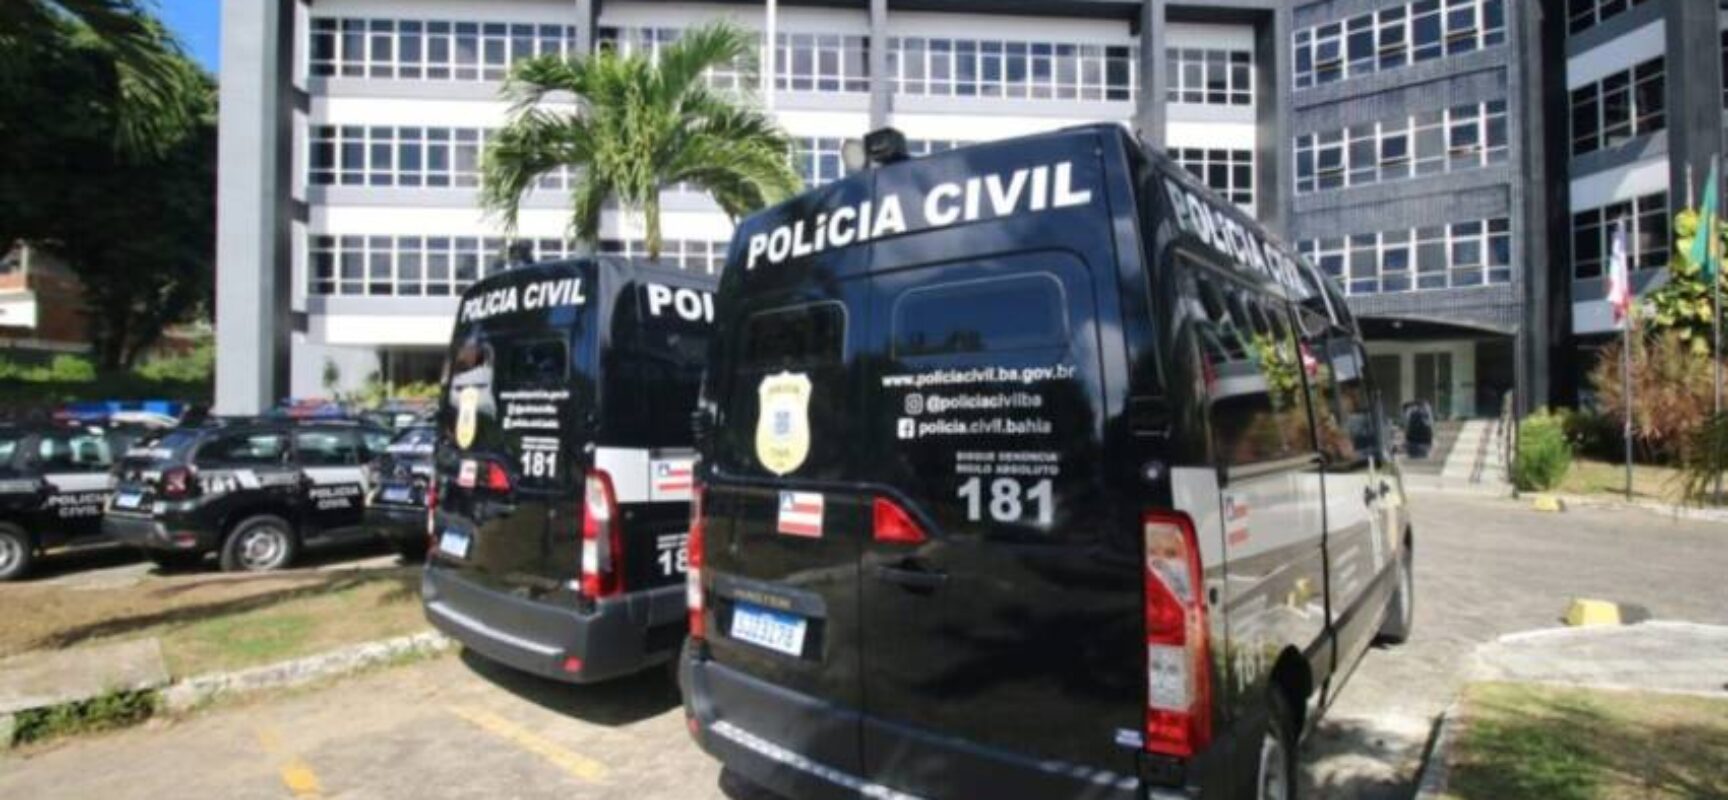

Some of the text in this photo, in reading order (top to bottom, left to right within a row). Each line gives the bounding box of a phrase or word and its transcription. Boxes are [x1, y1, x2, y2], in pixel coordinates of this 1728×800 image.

[923, 161, 1091, 227] CIVIL
[524, 278, 586, 312] CIVIL
[522, 451, 556, 477] 181
[199, 477, 235, 494] 181
[958, 477, 1053, 525] 181
[658, 550, 689, 575] 18
